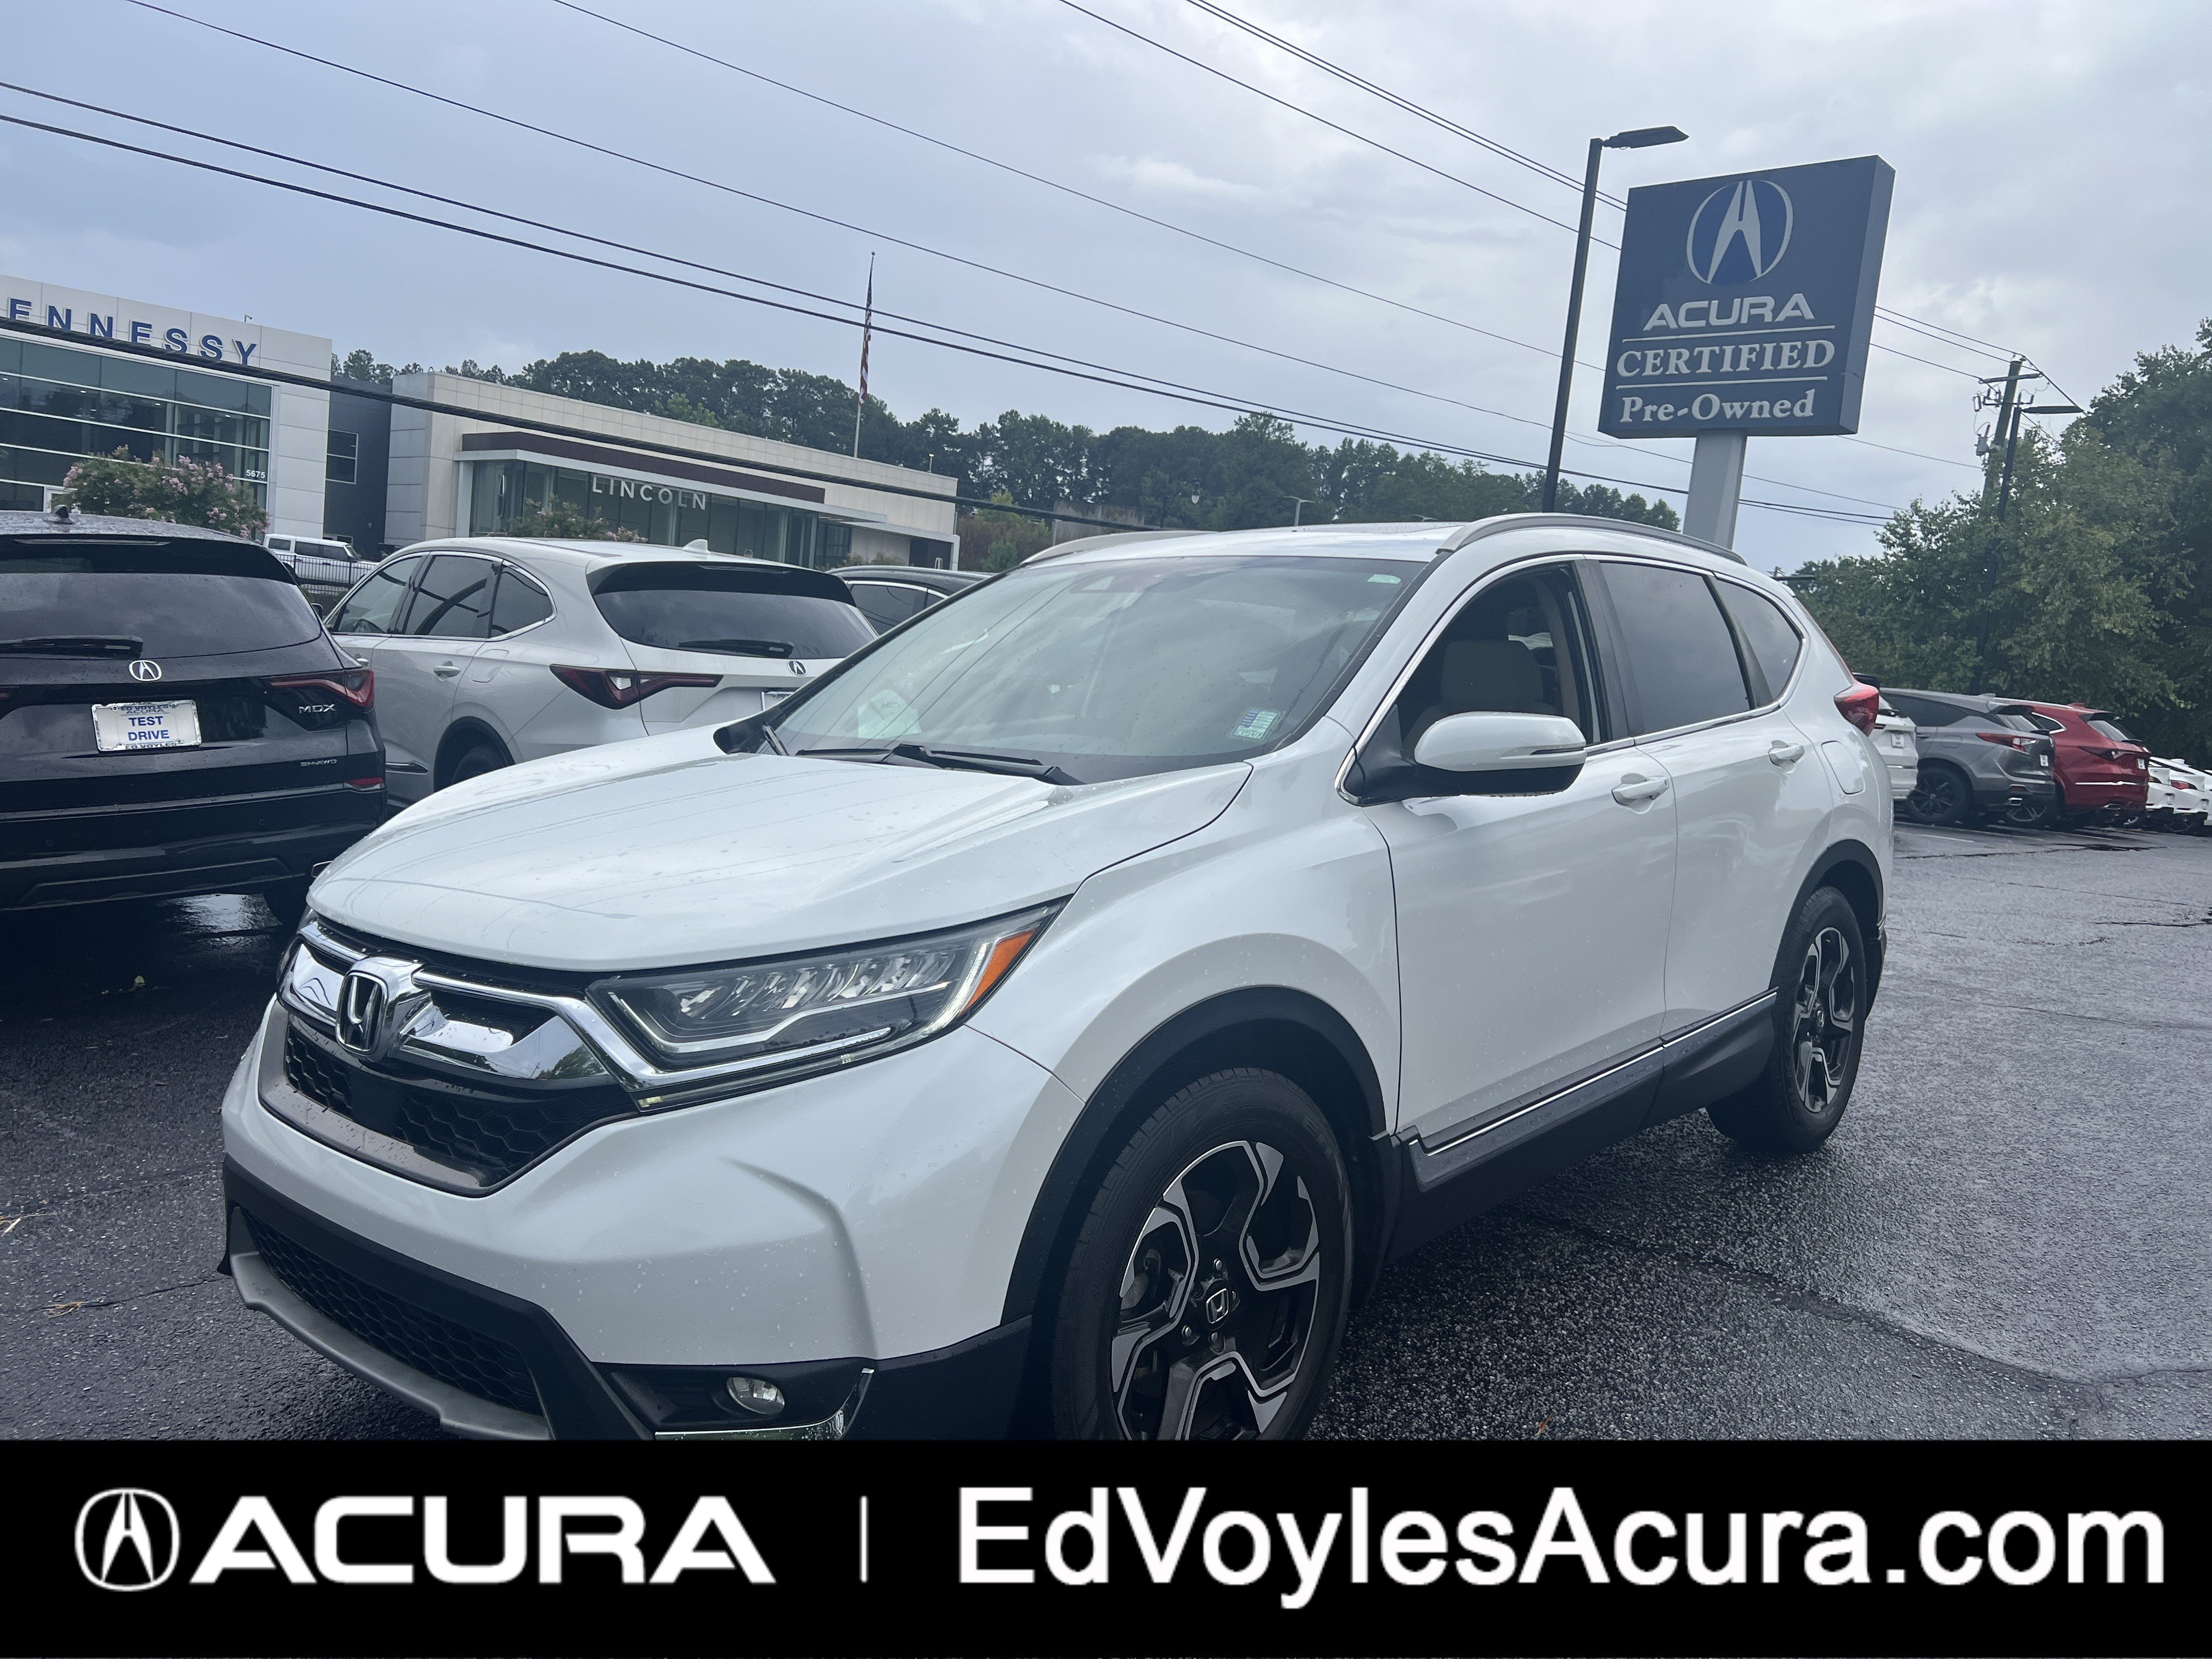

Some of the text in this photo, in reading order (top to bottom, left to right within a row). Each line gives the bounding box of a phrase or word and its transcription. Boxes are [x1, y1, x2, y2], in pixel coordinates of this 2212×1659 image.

[1642, 292, 1815, 331] ACURA
[1616, 339, 1836, 377] CERTIFIED
[1620, 388, 1815, 423] Pre-Owned
[246, 469, 266, 479] 5675
[592, 475, 707, 511] LINCOLN
[128, 715, 163, 726] TEST
[298, 704, 335, 714] MDX
[128, 730, 170, 741] DRIVE
